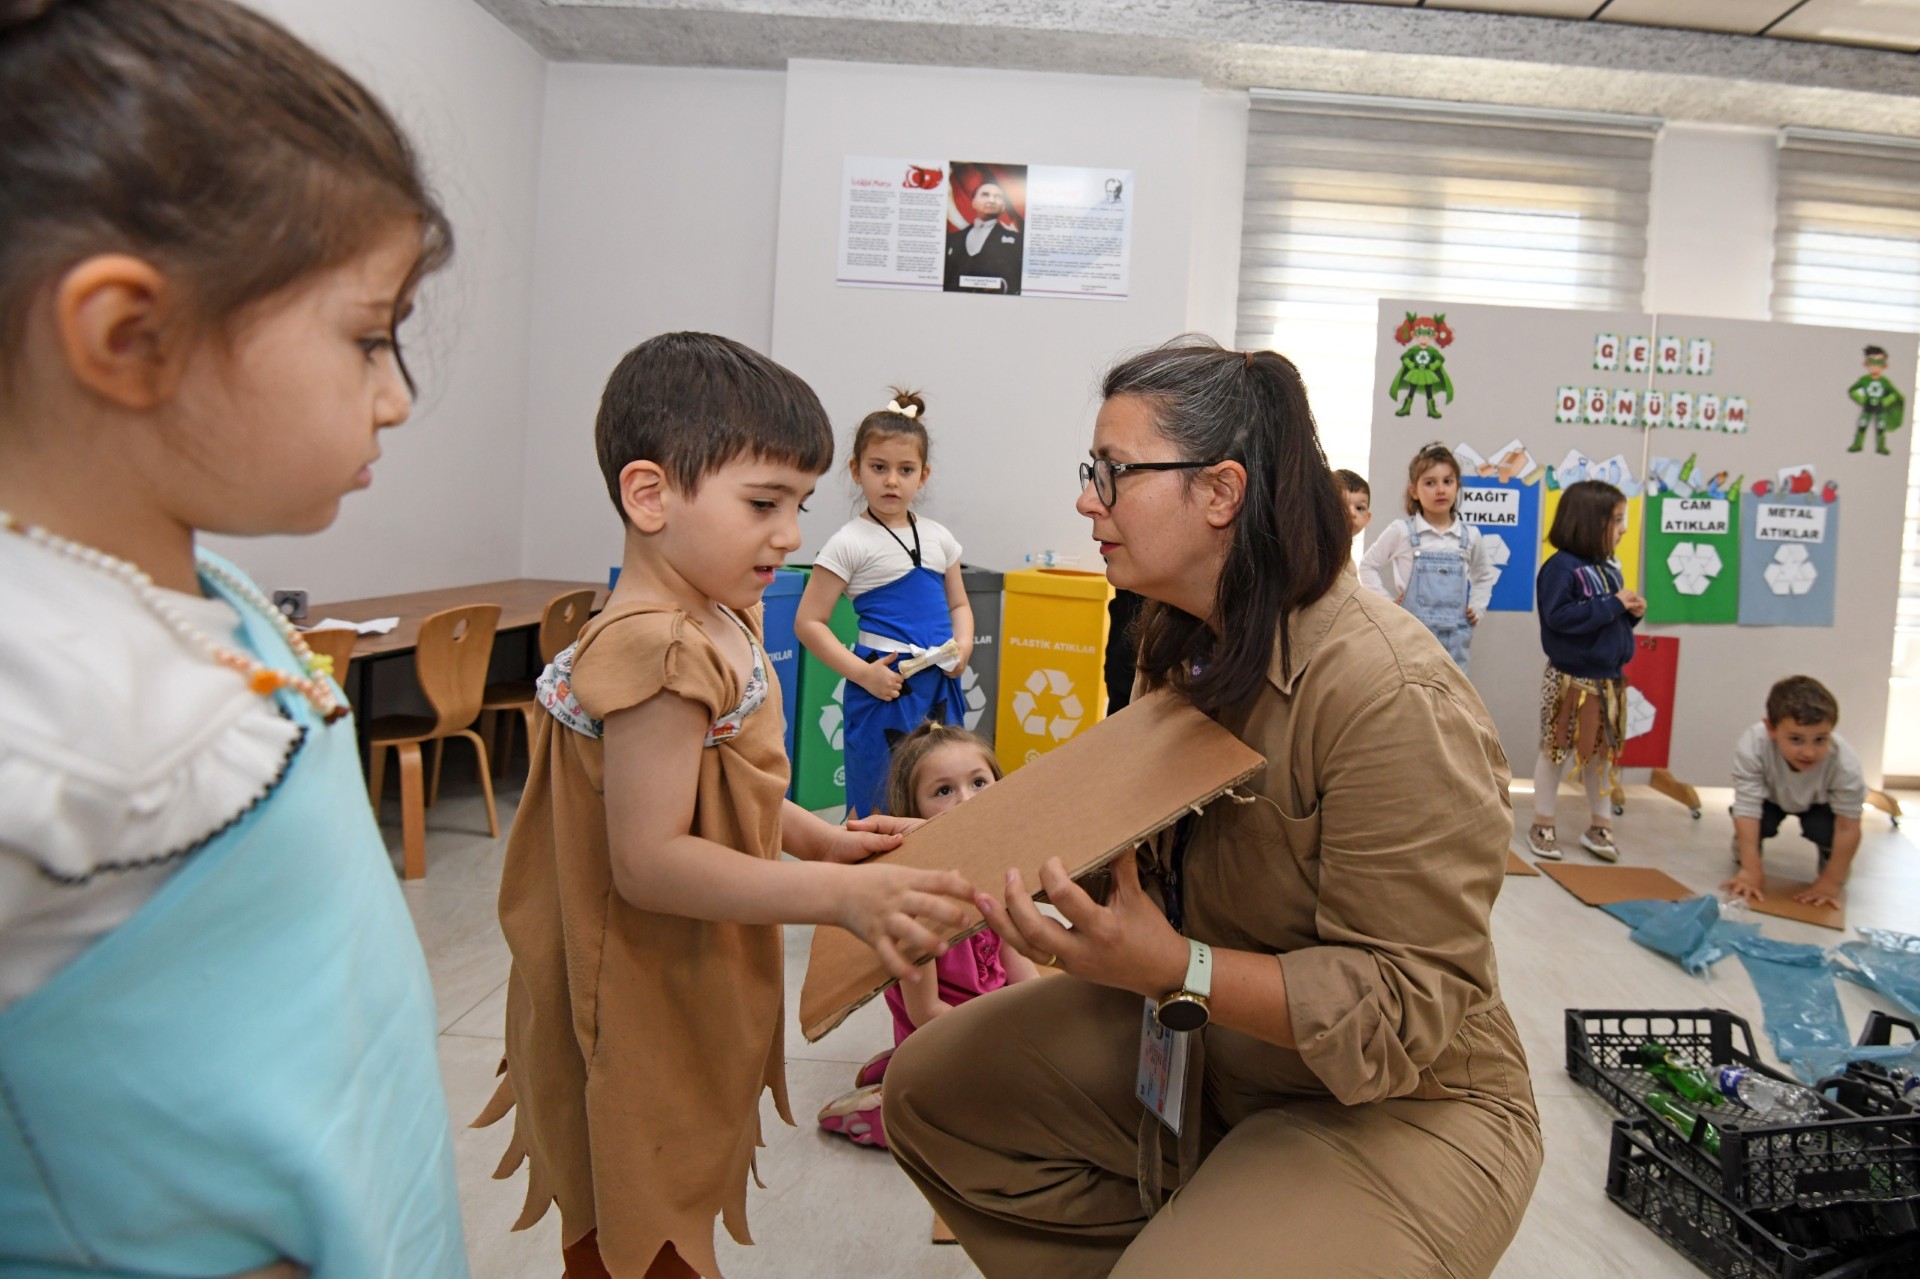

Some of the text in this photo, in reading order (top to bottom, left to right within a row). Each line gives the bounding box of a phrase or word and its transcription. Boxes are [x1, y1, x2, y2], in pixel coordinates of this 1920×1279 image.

[1601, 343, 1705, 367] GERİ
[1562, 392, 1745, 423] DÖNÜŞÜM
[1463, 490, 1509, 502] KAĞIT
[1680, 500, 1711, 511] CAM
[1767, 507, 1814, 519] METAL
[1665, 520, 1726, 531] ATIKLAR
[1760, 528, 1819, 540] ATIKLAR
[1010, 636, 1097, 655] PLASTİK ATIKLAR
